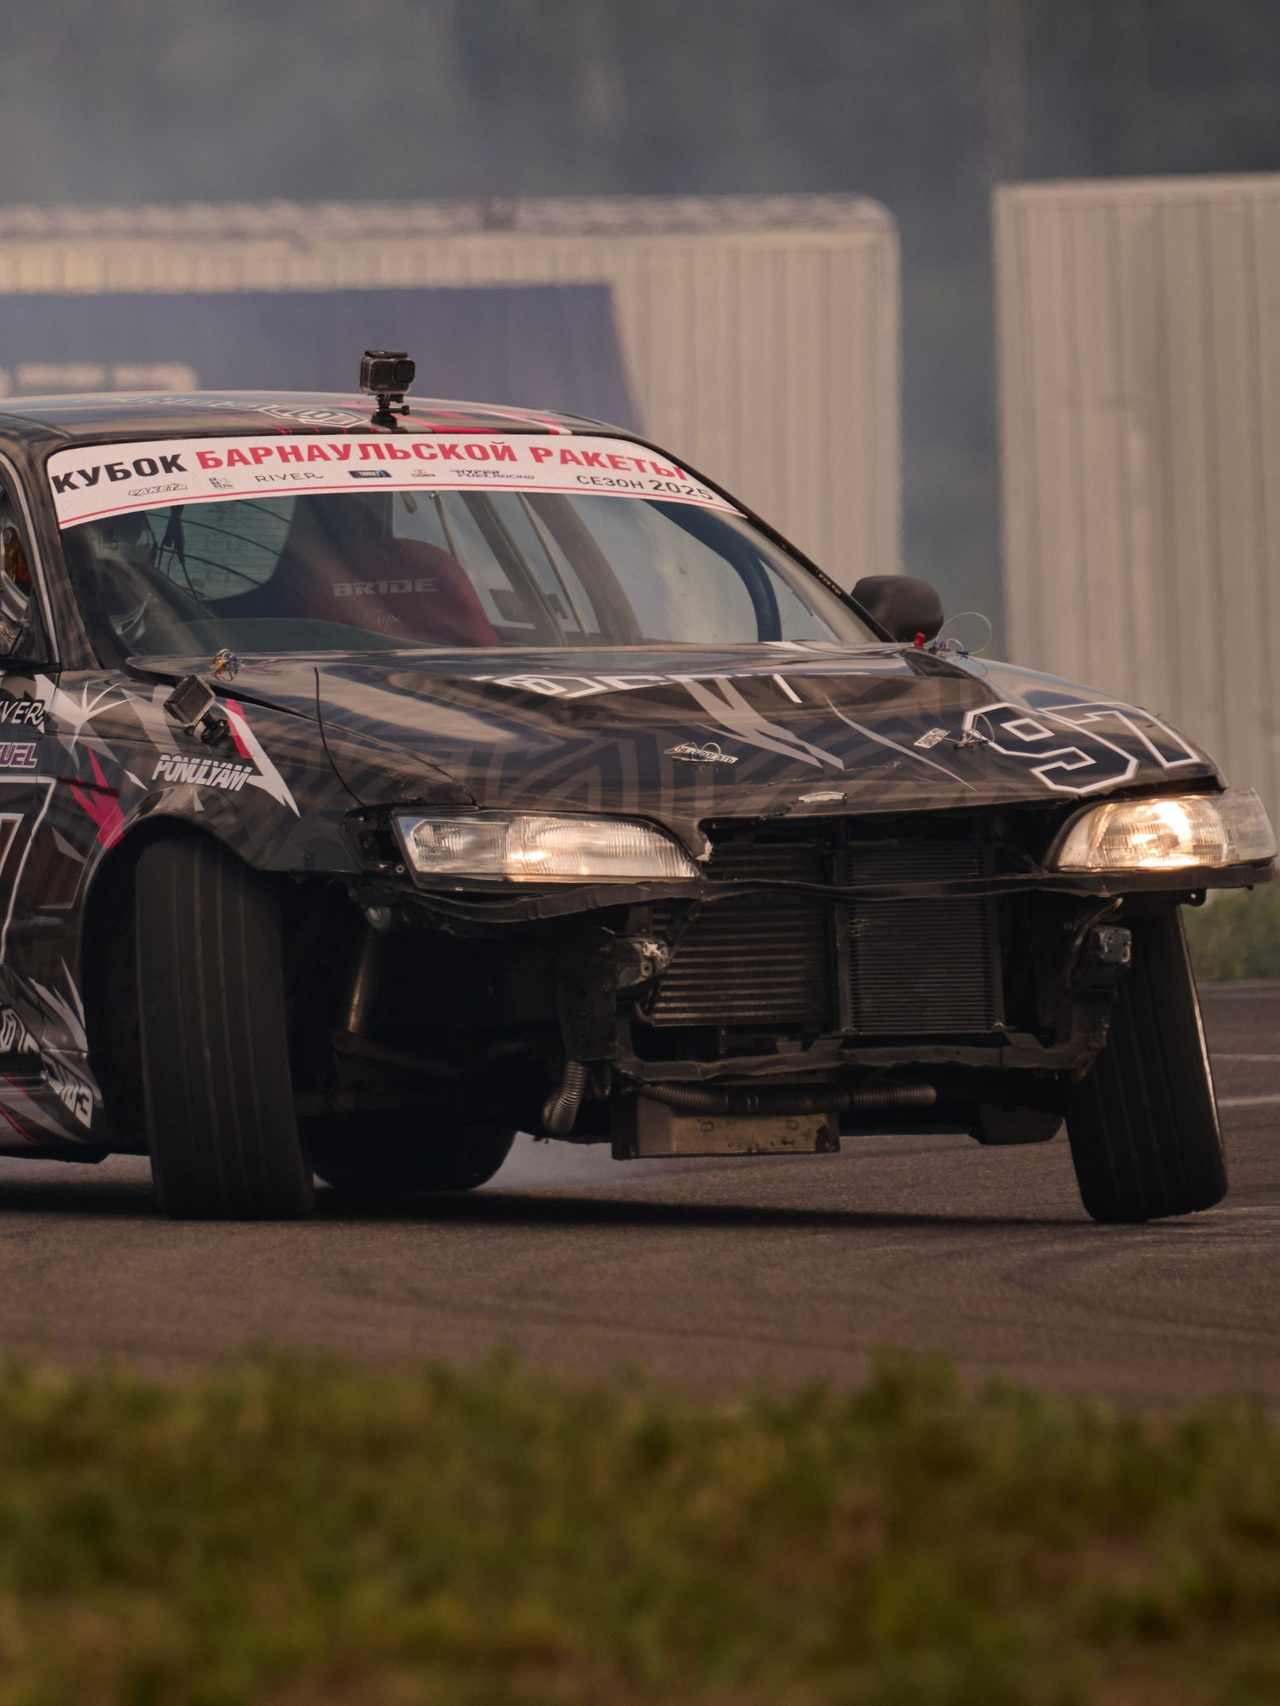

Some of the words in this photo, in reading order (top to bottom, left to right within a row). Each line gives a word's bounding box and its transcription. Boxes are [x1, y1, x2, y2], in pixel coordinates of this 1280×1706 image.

[51, 453, 188, 494] КУБОК
[195, 441, 518, 470] БАРНАУЛЬСКОЙ
[529, 446, 687, 481] РАКЕТЫ
[254, 472, 324, 483] RIVER
[576, 475, 645, 490] СЕЗОН
[648, 479, 714, 500] 2025
[331, 578, 437, 597] BRIDE
[962, 702, 1201, 796] 97
[151, 754, 253, 791] PONULYAM
